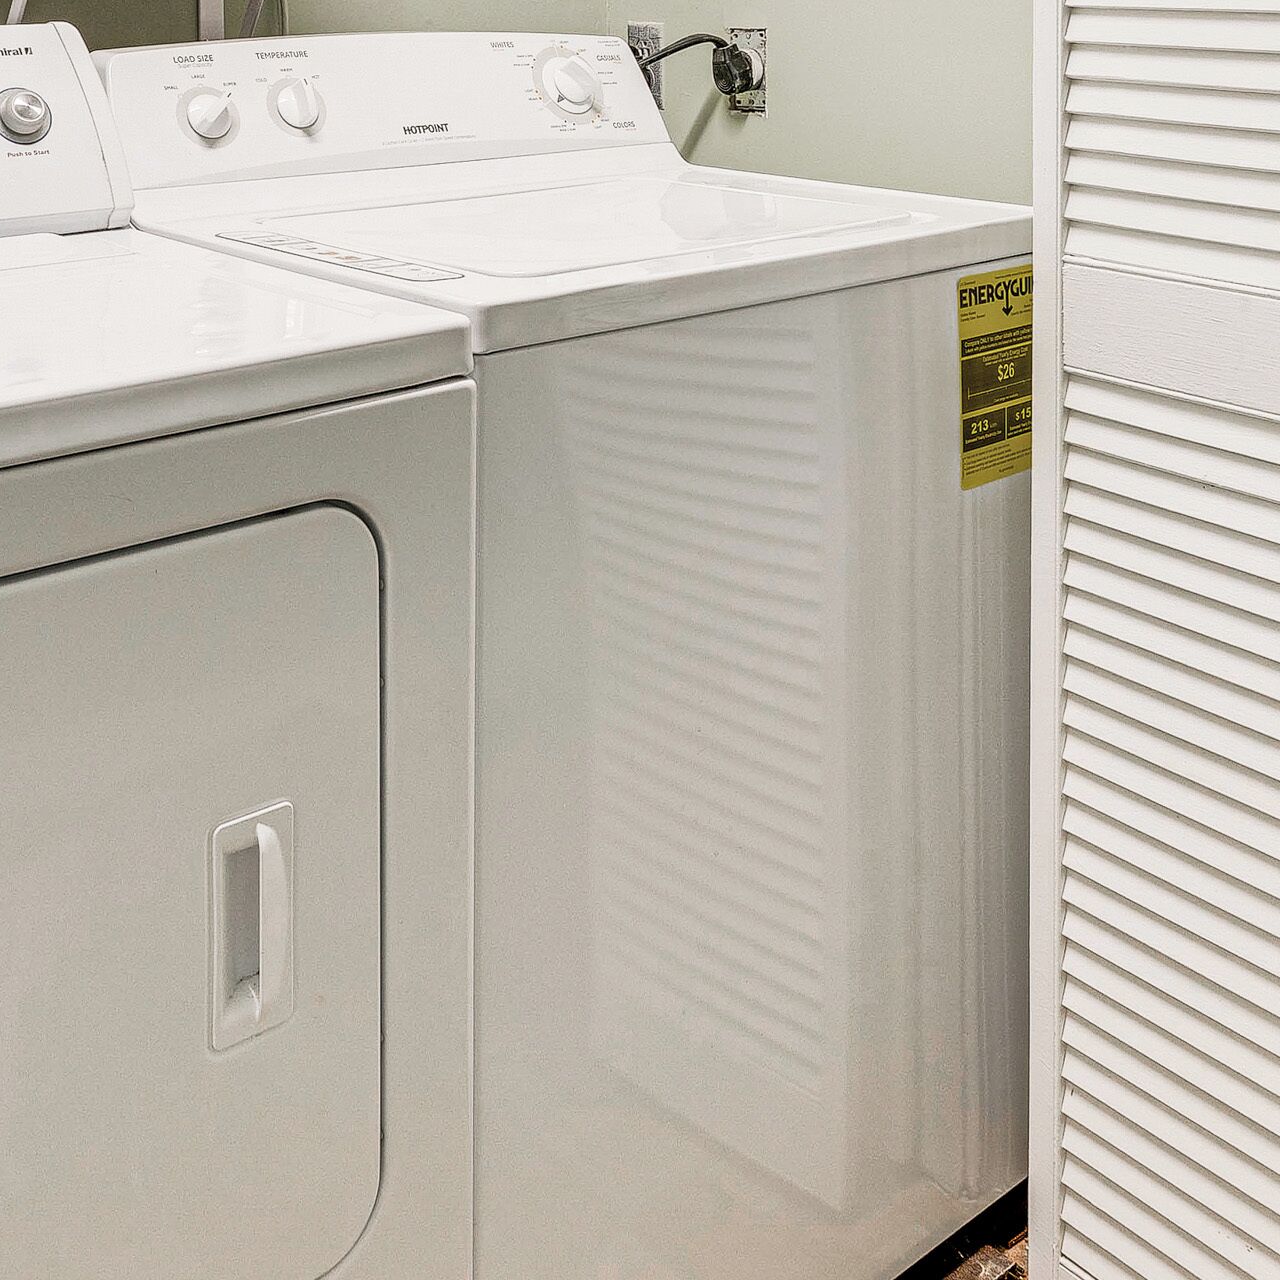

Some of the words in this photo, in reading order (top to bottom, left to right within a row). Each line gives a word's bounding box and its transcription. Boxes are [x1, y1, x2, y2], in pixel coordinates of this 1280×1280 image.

[173, 56, 195, 64] LOAD
[197, 54, 214, 63] SIZE
[255, 50, 309, 60] TEMPERATURE
[402, 123, 449, 135] HOTPOINT
[960, 275, 1033, 309] ENERGYGUI
[997, 362, 1015, 382] $26
[971, 419, 989, 435] 213
